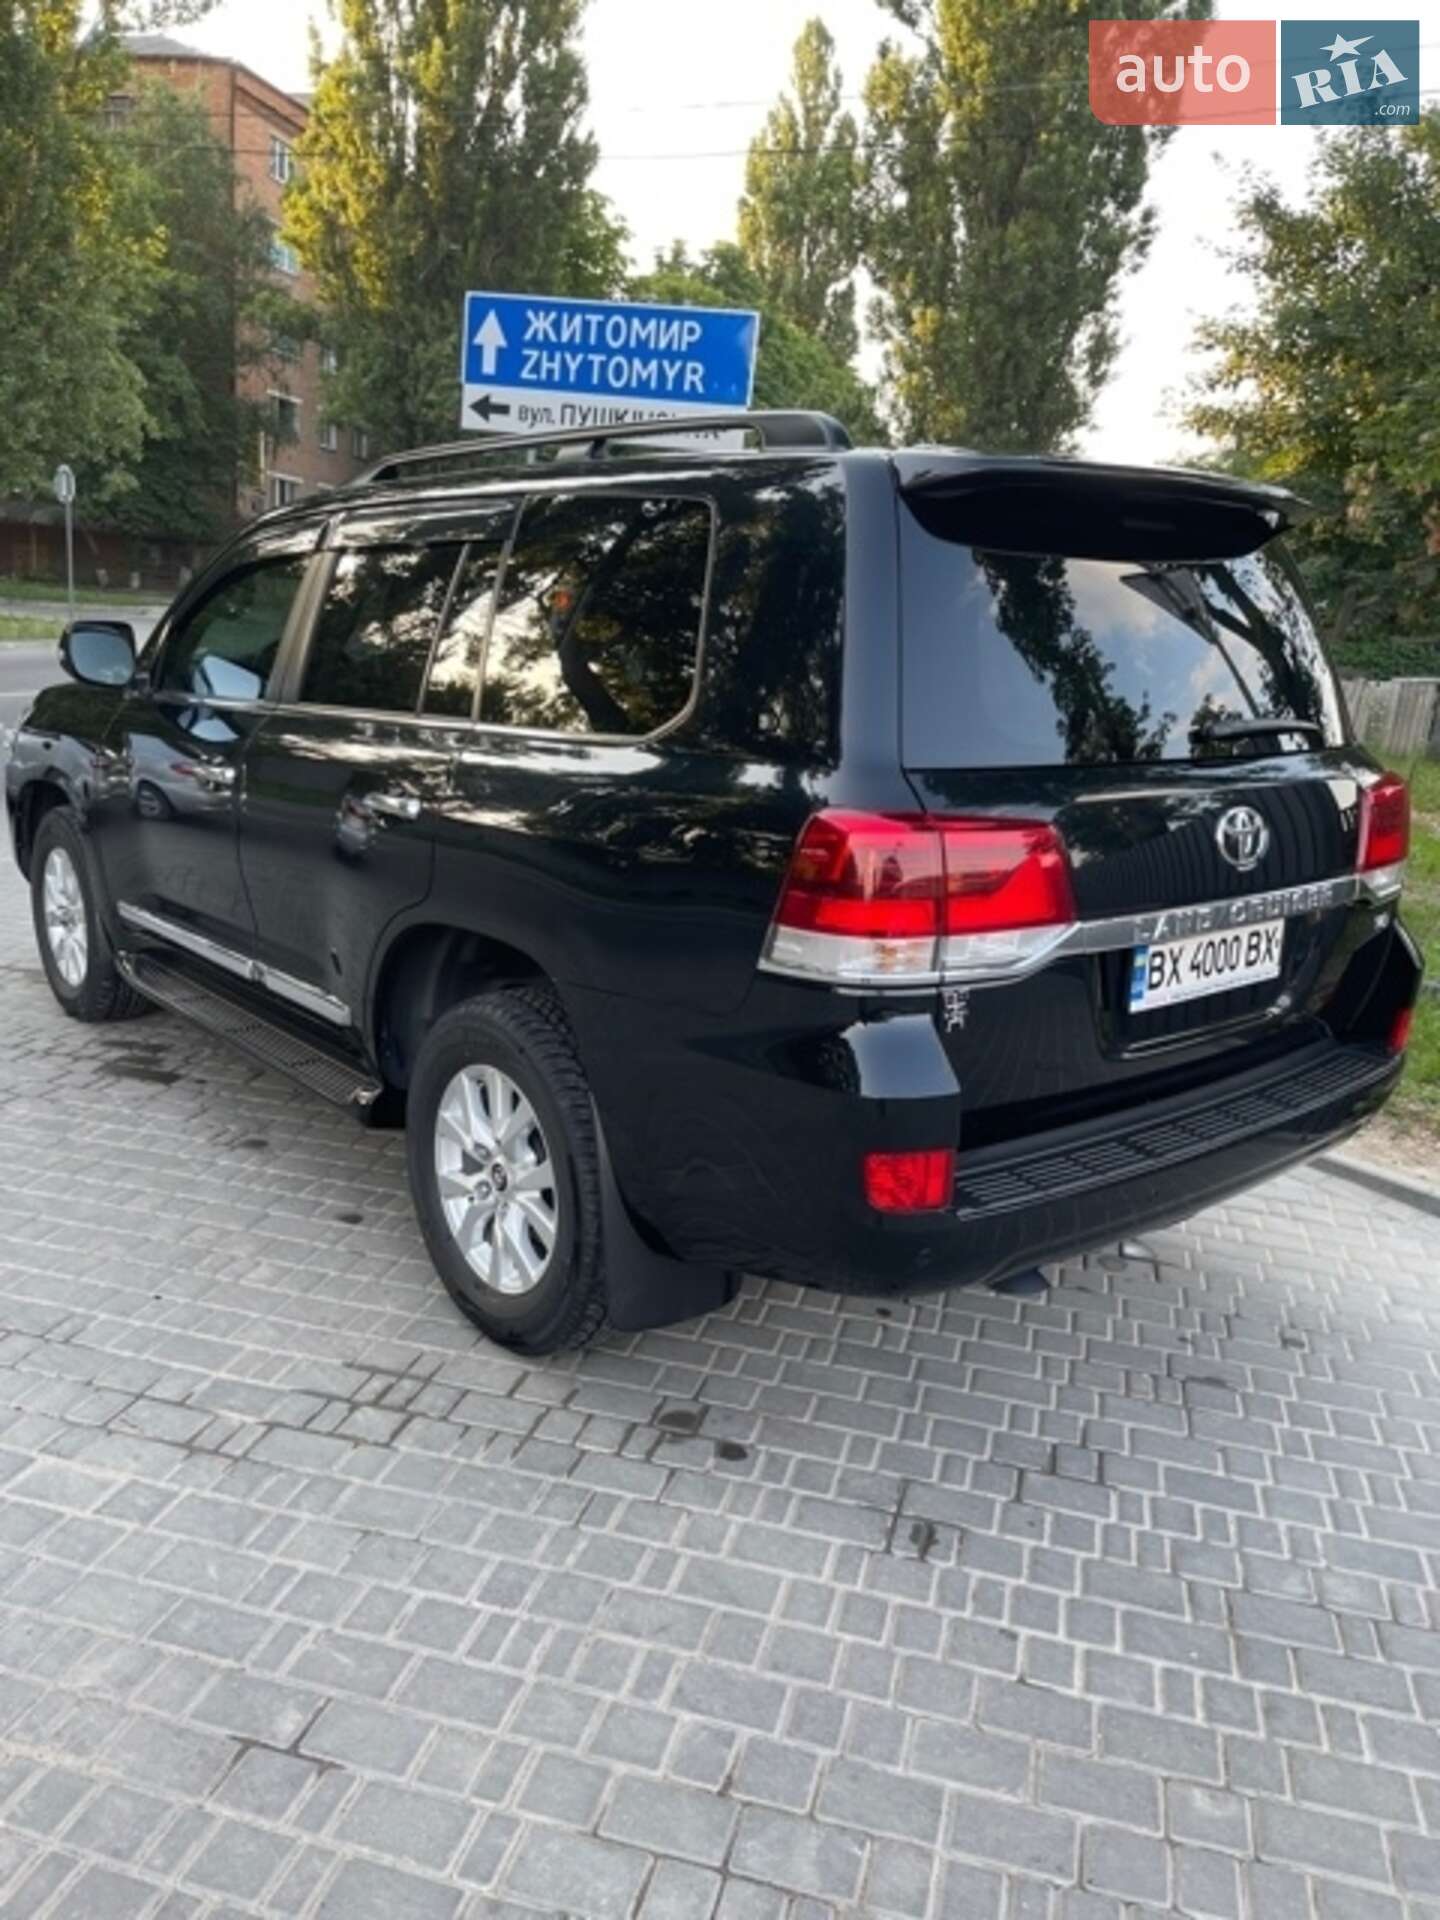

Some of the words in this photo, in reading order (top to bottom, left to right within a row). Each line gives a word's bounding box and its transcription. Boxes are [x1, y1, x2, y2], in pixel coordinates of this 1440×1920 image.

[523, 309, 702, 351] ЖИТОМИР
[520, 350, 705, 393] ZHYTOMYR
[1148, 946, 1183, 990] BX
[1190, 935, 1240, 980] 4000
[1244, 928, 1278, 968] BX
